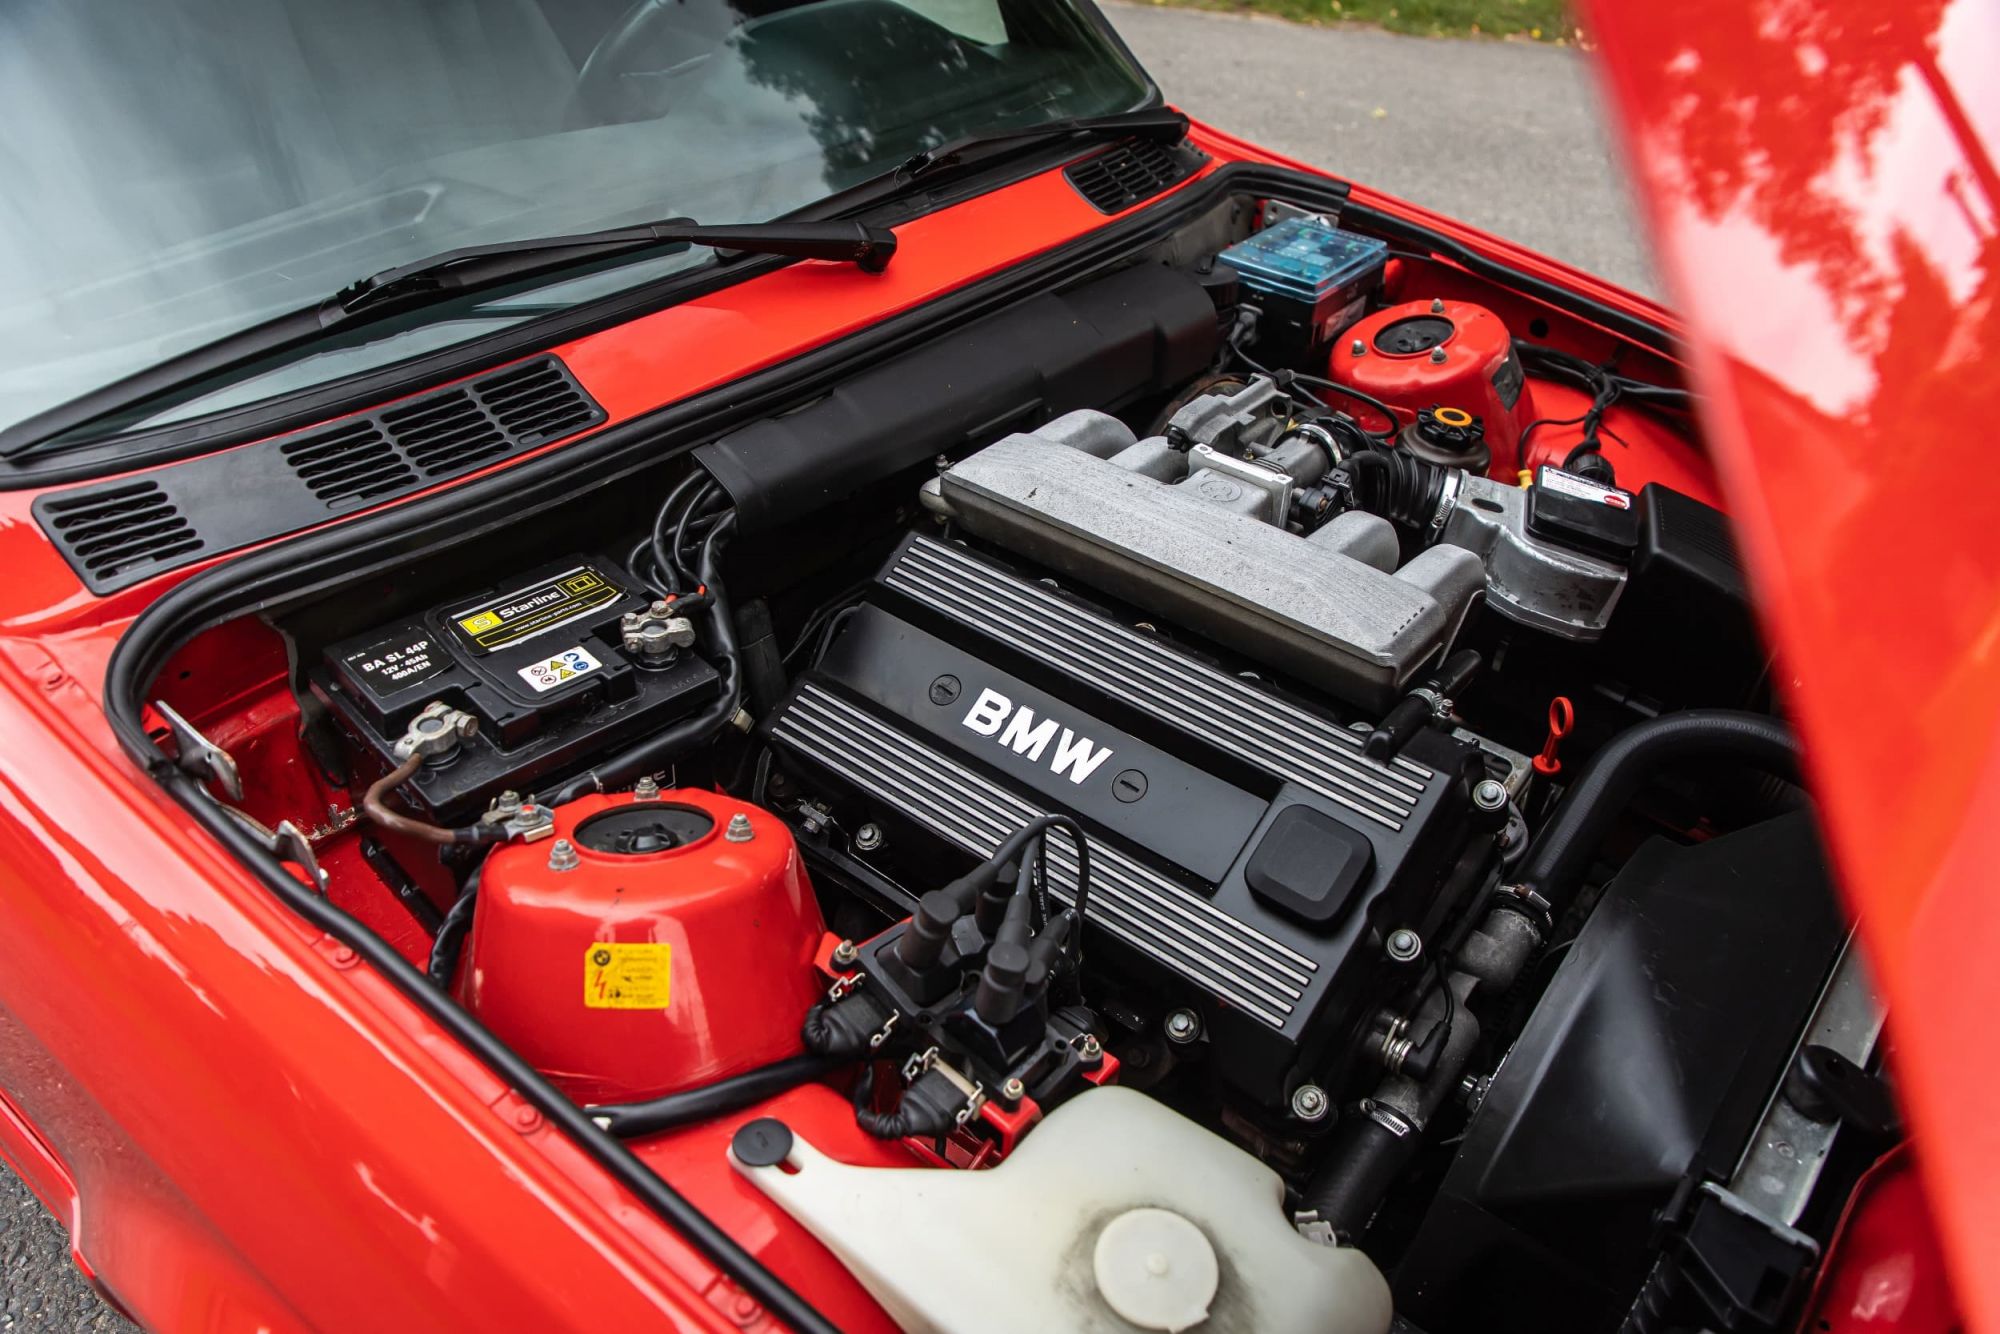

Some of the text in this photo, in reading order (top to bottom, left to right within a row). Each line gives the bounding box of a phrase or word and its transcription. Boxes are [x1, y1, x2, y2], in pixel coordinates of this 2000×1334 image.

[499, 590, 561, 619] Starline
[362, 640, 429, 672] BA SL 44P
[381, 664, 399, 675] 12V
[404, 653, 429, 666] 45Ah
[962, 687, 1114, 785] BMW
